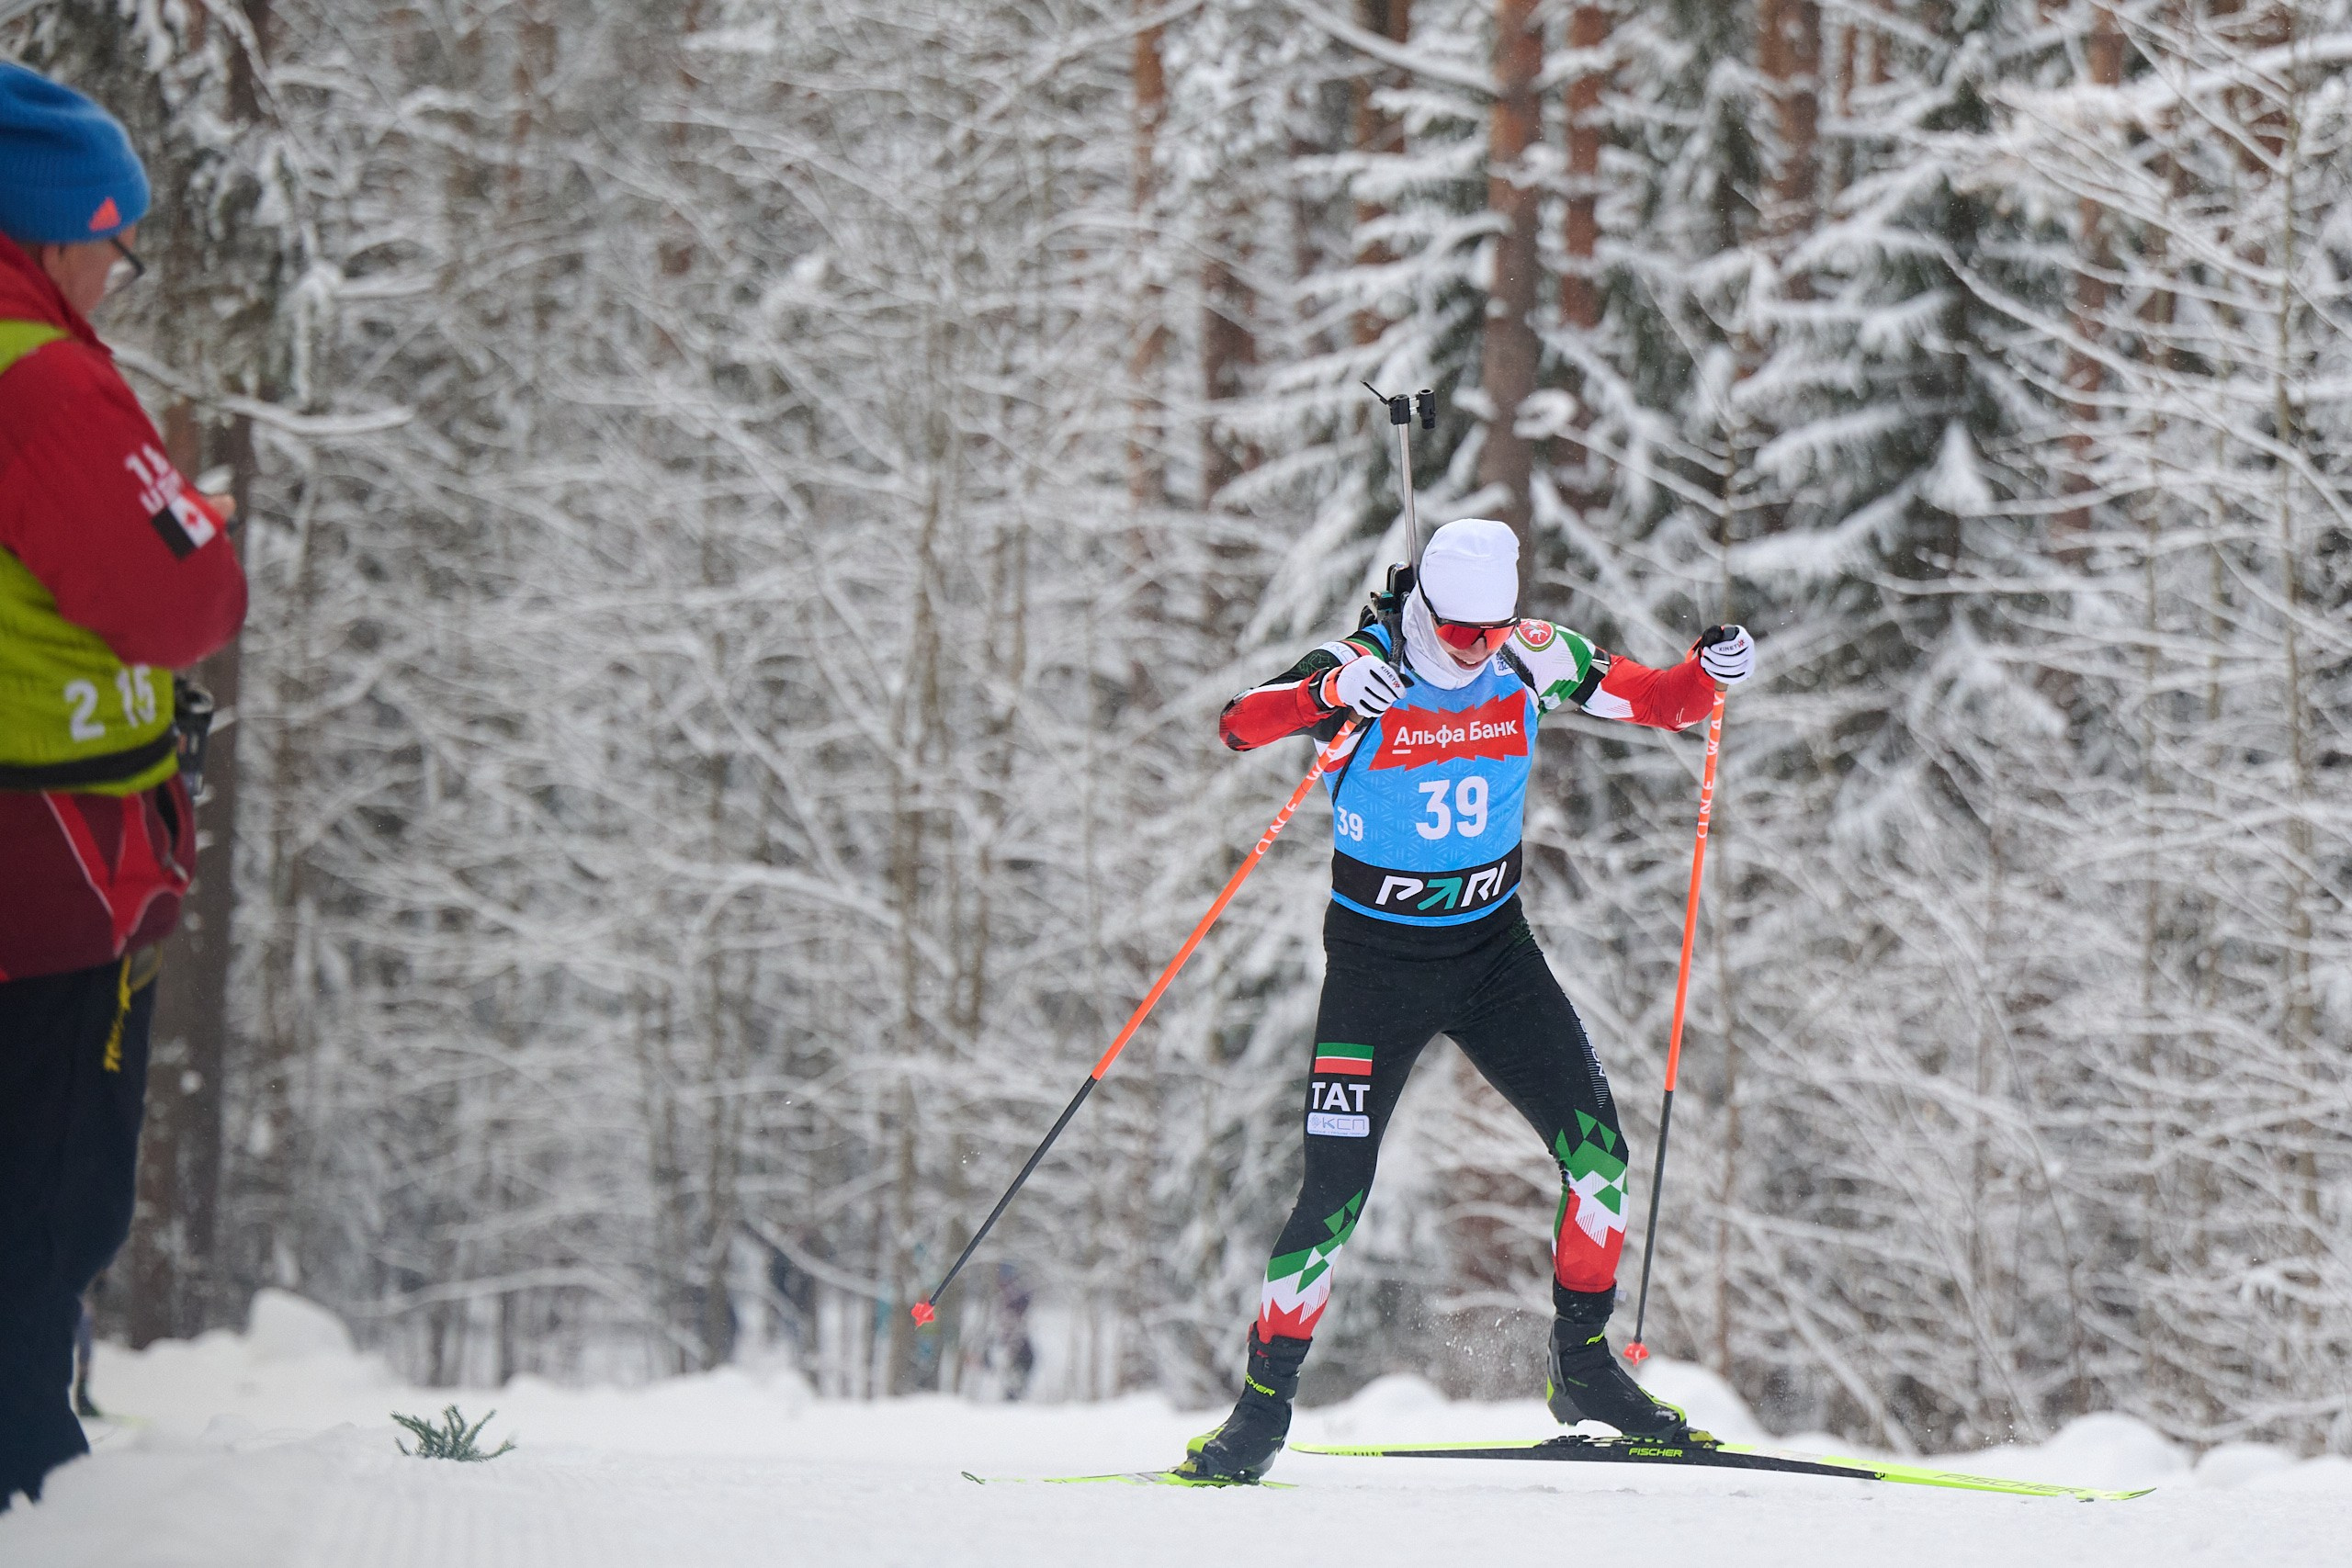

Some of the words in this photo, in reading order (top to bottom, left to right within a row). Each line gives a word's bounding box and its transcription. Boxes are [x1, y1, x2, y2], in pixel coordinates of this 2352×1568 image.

[1393, 725, 1465, 750] Альфа
[1469, 719, 1518, 741] Банк
[1415, 775, 1489, 840] 39
[1337, 806, 1364, 842] 39
[1374, 861, 1508, 911] PARI
[1246, 1372, 1276, 1397] CHER
[1628, 1447, 1683, 1459] FISCHER
[1934, 1472, 2086, 1495] FISCHER
